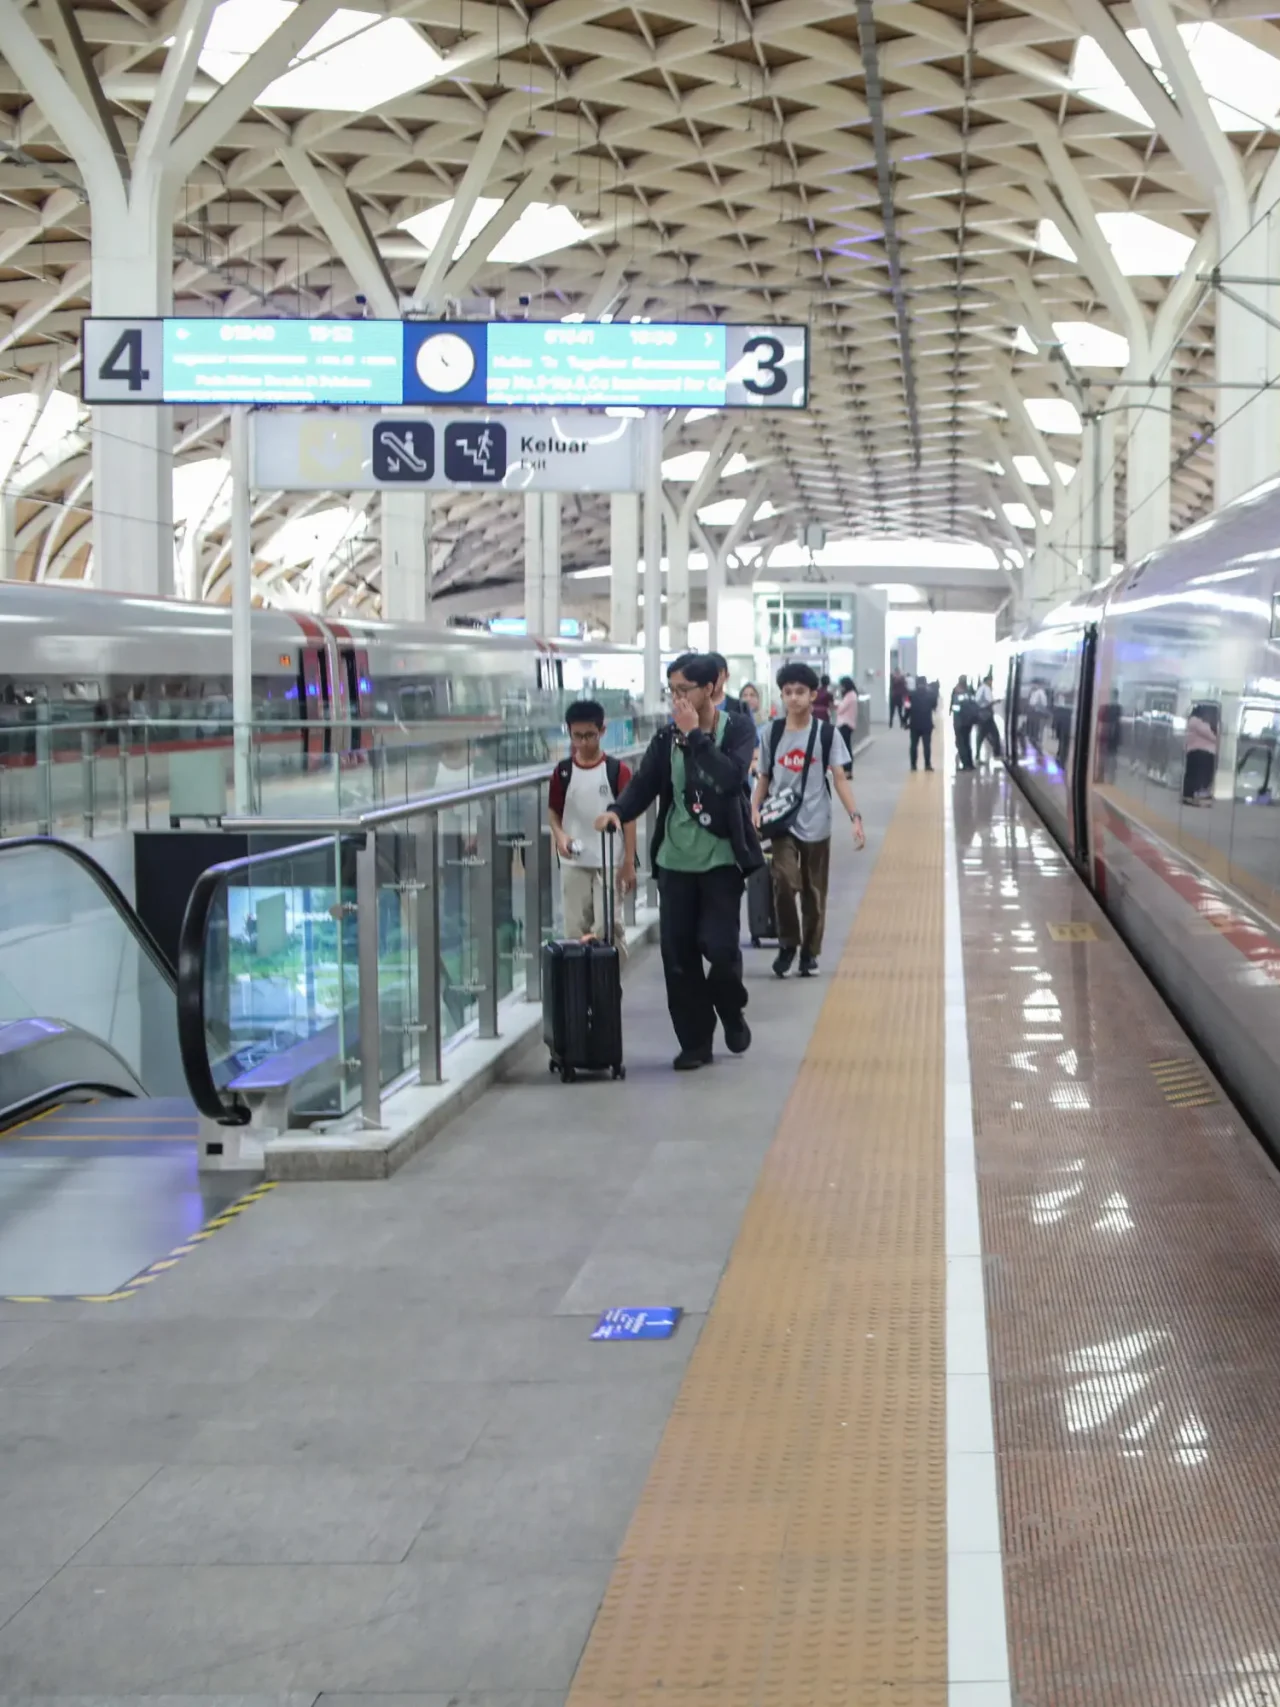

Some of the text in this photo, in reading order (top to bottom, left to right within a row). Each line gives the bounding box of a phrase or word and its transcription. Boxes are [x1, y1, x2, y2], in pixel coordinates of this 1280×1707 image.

[99, 328, 150, 391] 4
[742, 336, 788, 396] 3
[521, 436, 588, 454] Keluar
